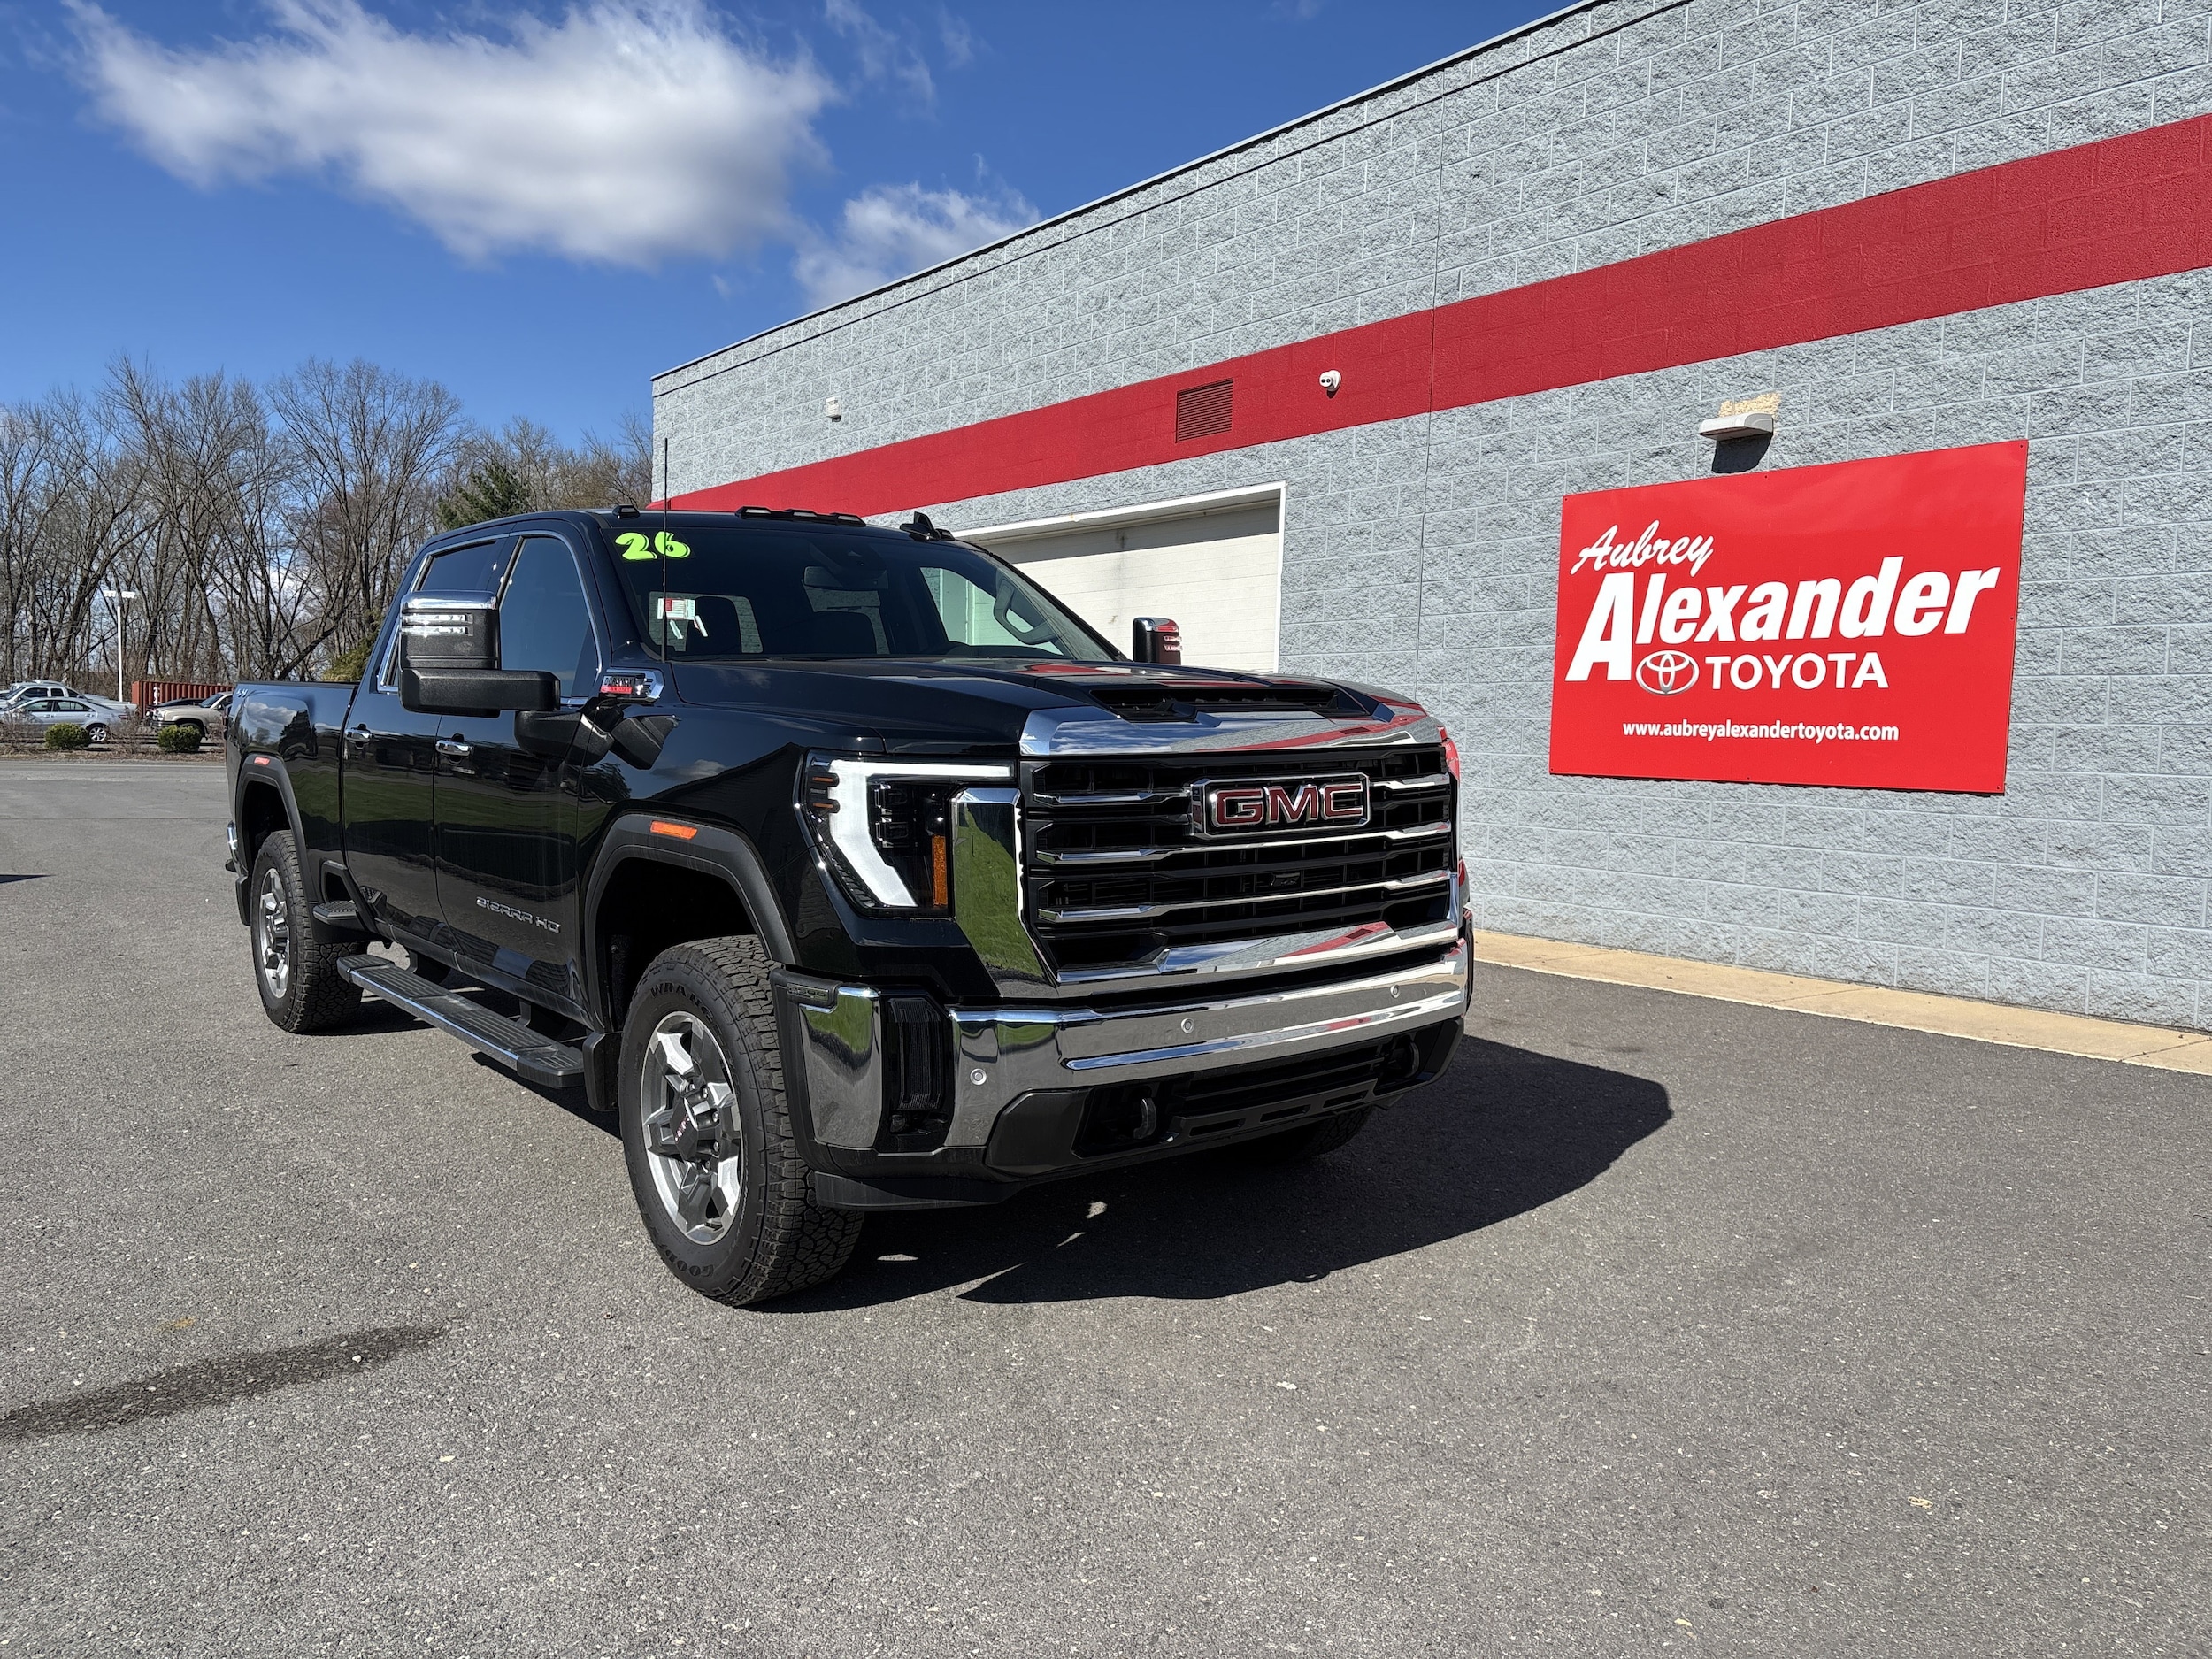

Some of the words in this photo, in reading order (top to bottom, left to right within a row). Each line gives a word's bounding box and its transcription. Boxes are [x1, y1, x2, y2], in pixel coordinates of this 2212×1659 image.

[615, 531, 691, 561] 26
[1571, 519, 1714, 578] Aubrey
[1565, 556, 2001, 682] Alexander
[1705, 651, 1889, 690] TOYOTA
[1623, 718, 1900, 743] www.aubreyalexandertoyota.com
[1211, 782, 1363, 827] GMC
[476, 896, 533, 924] SIERRA
[535, 916, 561, 933] HD
